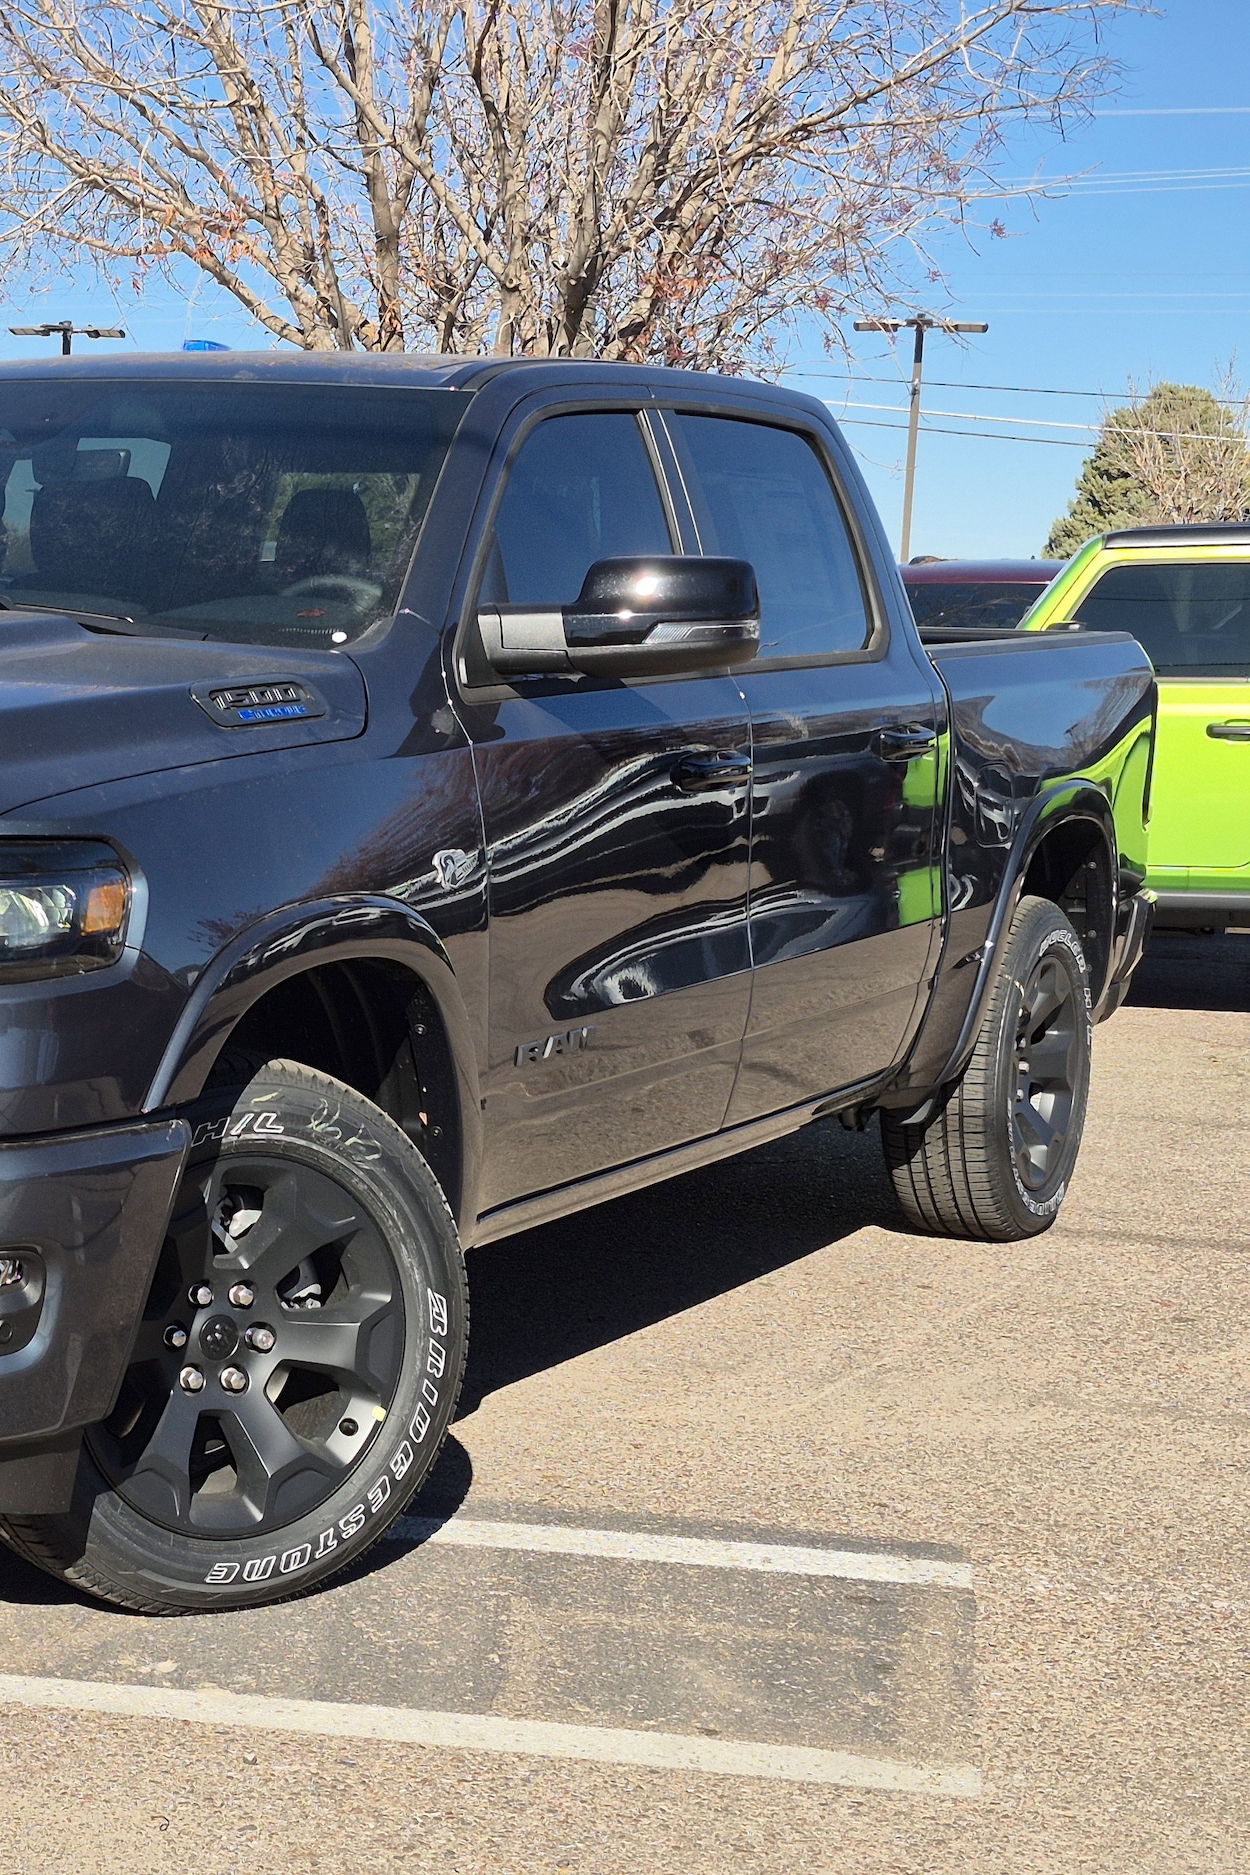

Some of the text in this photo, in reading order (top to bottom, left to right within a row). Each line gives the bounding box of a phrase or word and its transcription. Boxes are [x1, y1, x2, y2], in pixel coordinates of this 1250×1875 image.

[213, 686, 299, 711] 1500
[514, 1025, 599, 1067] RAM
[191, 1112, 285, 1148] H/L
[204, 1287, 449, 1585] BRIDGESTONE
